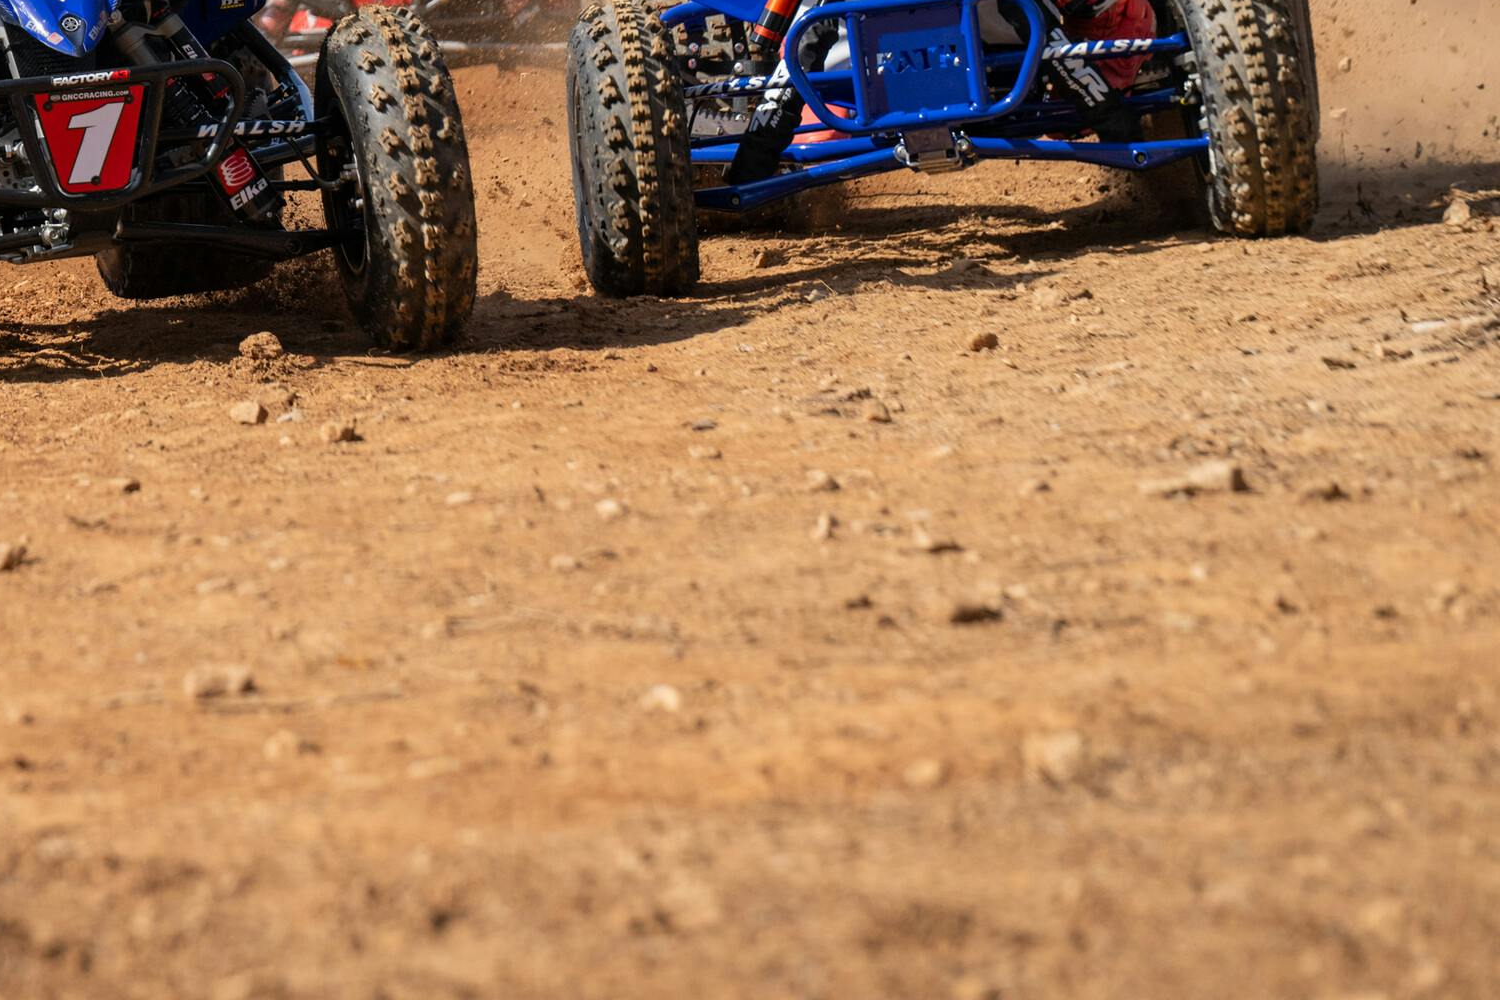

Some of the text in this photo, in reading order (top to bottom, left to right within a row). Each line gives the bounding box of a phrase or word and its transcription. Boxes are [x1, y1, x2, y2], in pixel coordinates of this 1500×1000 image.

[1042, 37, 1153, 60] WALSH
[68, 101, 125, 184] 1
[229, 177, 269, 211] Elka
